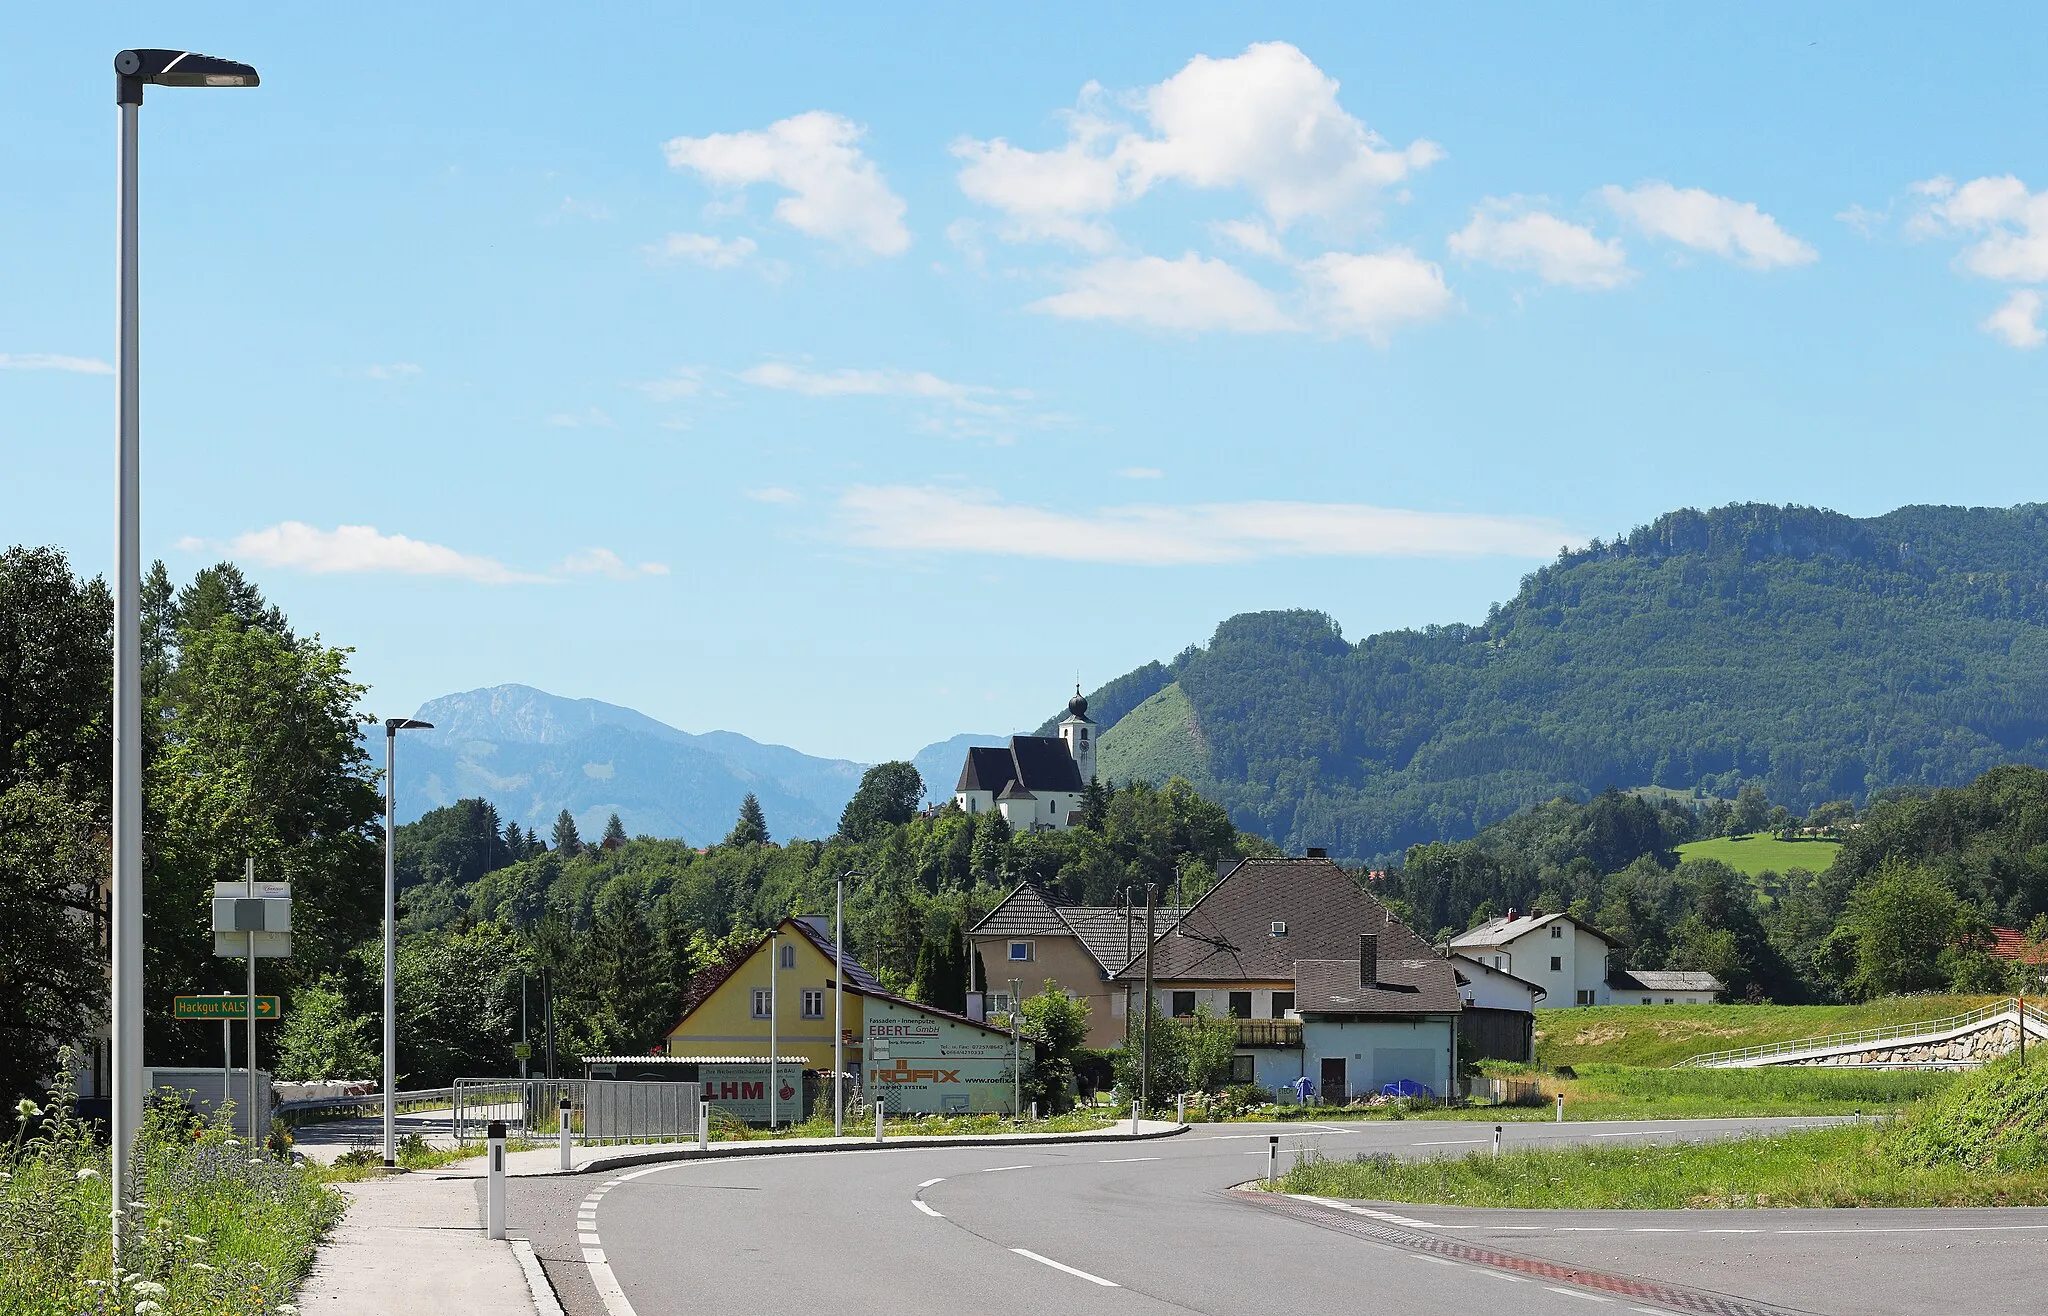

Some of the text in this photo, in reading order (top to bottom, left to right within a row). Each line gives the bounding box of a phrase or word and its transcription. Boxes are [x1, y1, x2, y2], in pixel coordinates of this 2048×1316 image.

[179, 1001, 245, 1014] Hackgut KALS
[869, 1026, 910, 1036] EBERT
[870, 1059, 960, 1083] RÖFIX
[706, 1082, 763, 1099] LHM
